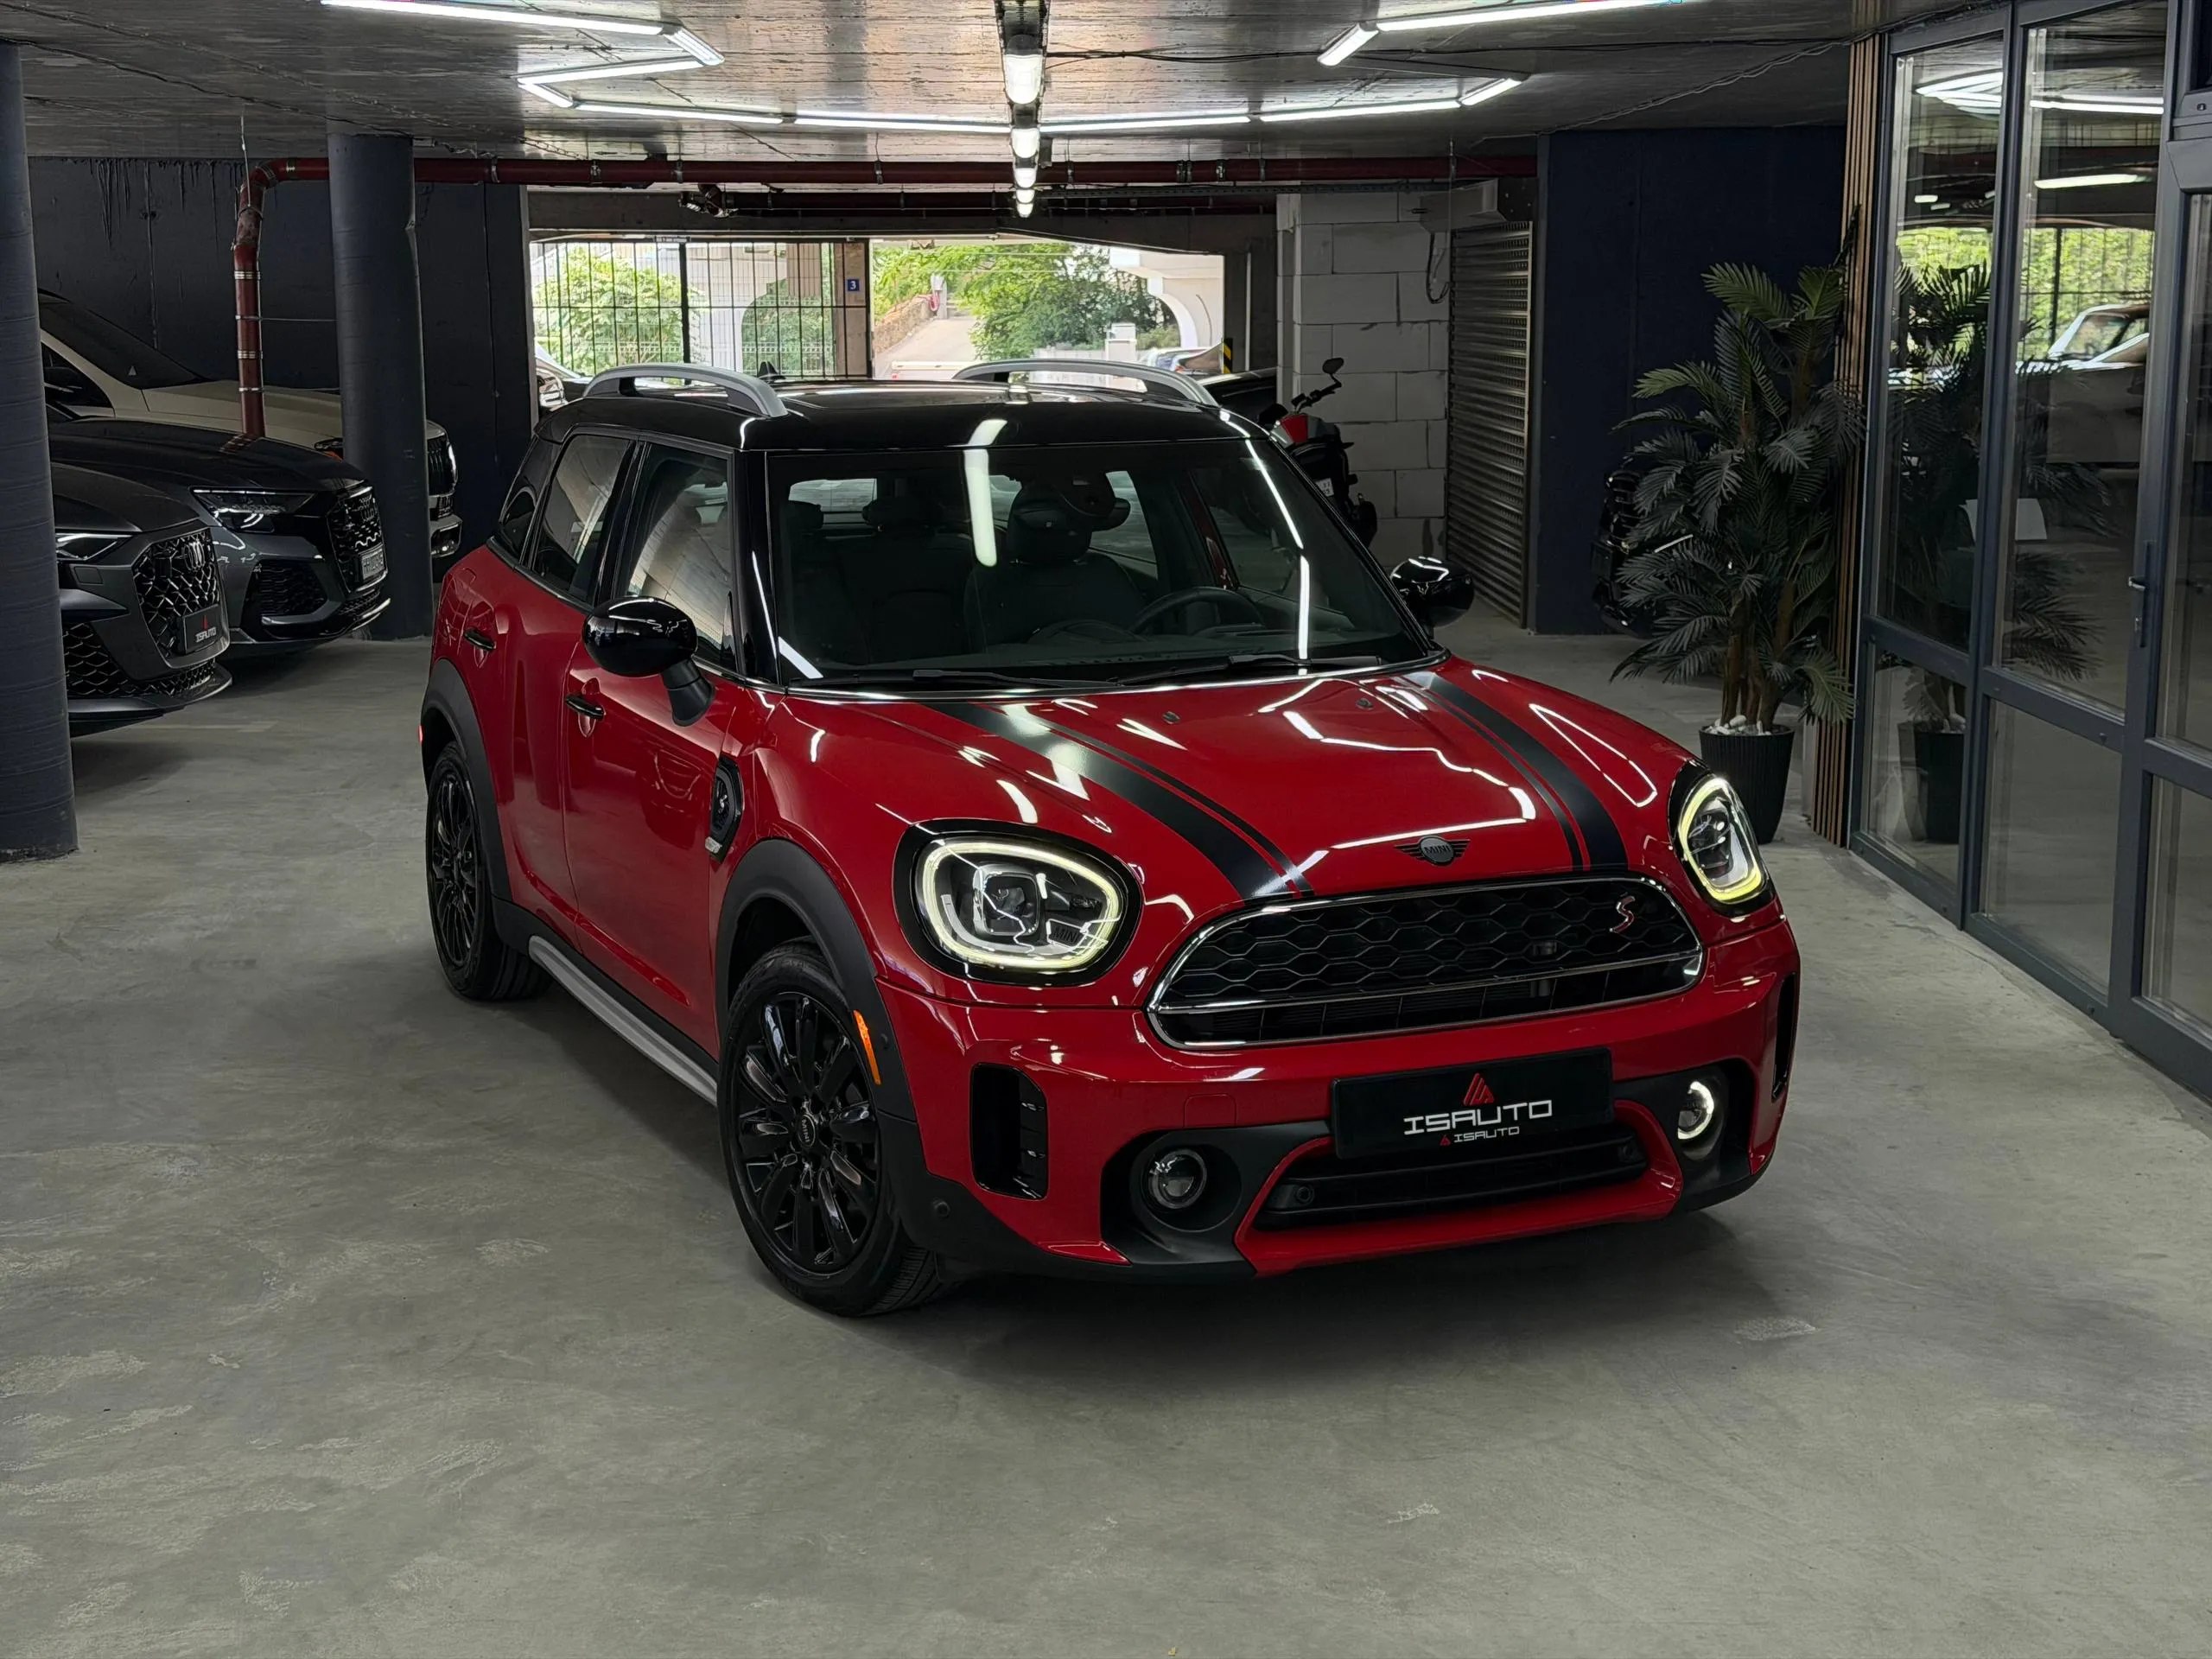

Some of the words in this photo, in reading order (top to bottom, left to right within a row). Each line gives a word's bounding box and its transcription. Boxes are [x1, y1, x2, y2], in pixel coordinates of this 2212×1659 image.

[849, 280, 856, 290] 3
[1424, 845, 1452, 855] MINI
[1403, 1099, 1553, 1135] ISAUTO
[1453, 1126, 1520, 1143] ISAUTO
